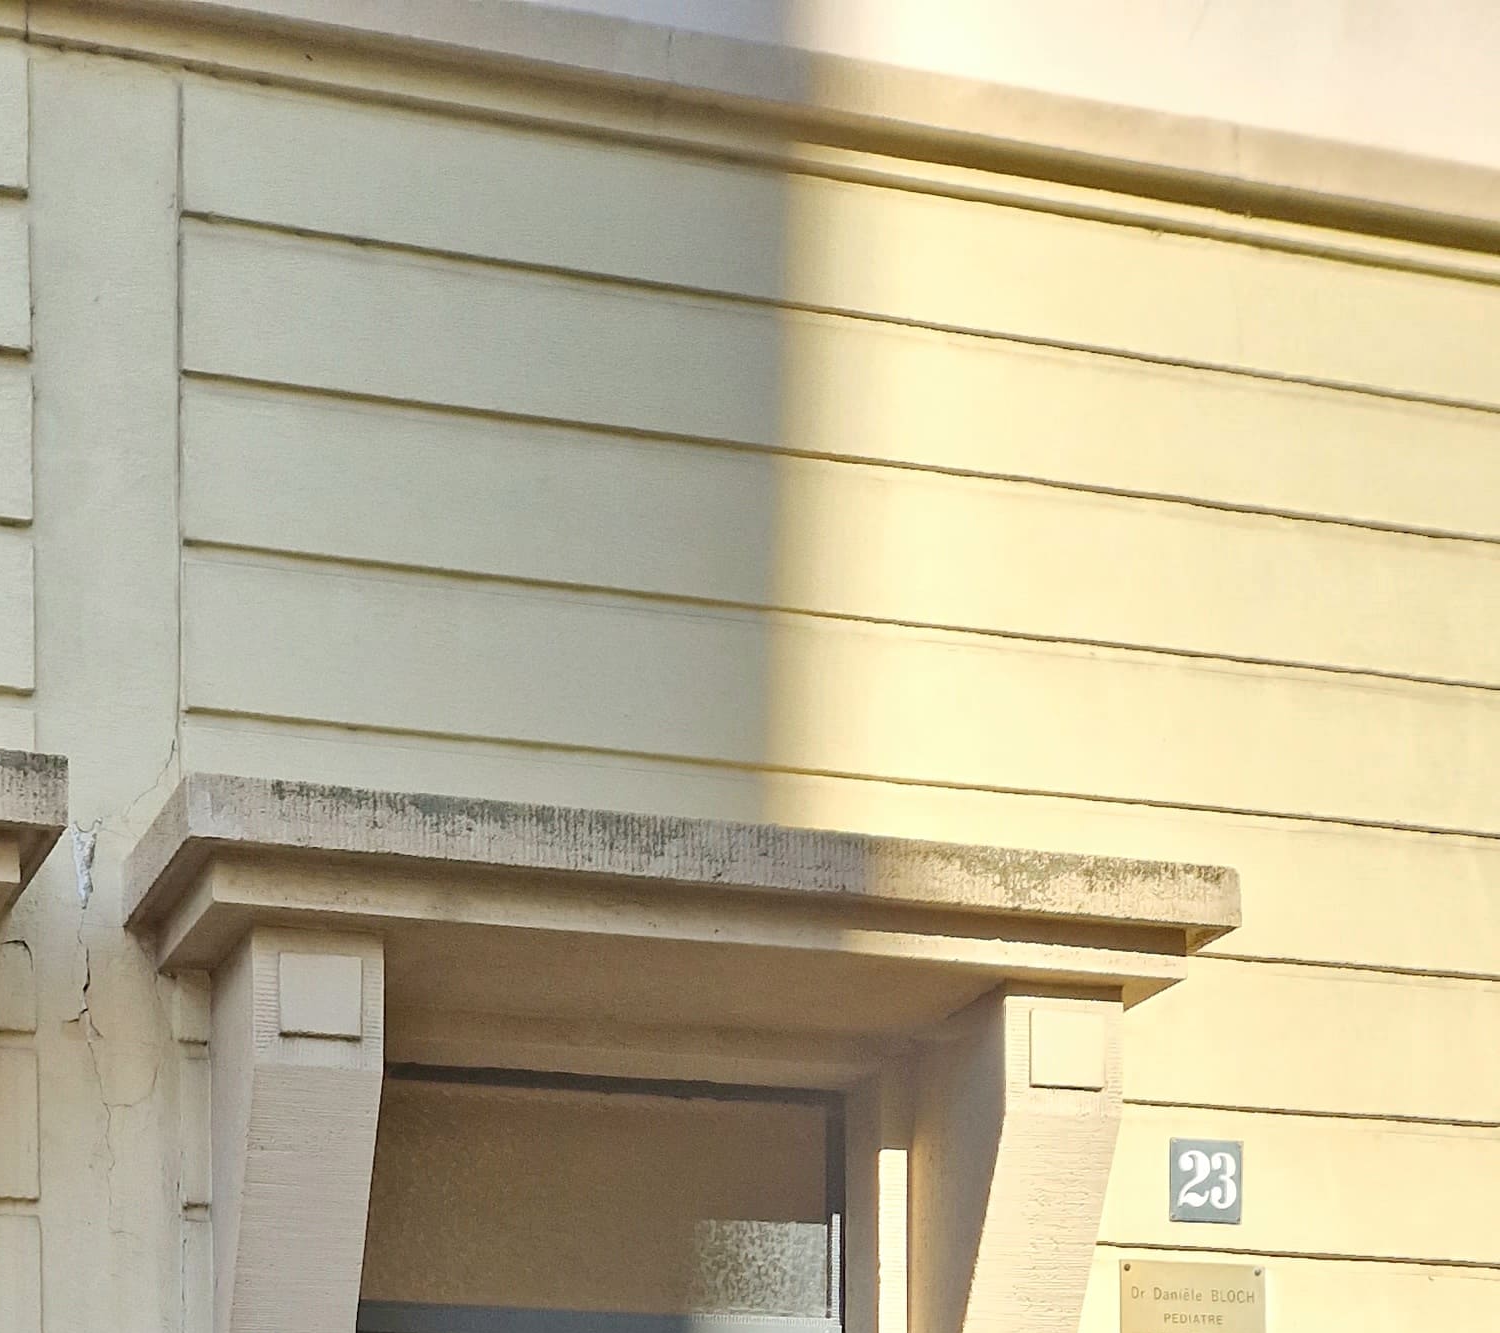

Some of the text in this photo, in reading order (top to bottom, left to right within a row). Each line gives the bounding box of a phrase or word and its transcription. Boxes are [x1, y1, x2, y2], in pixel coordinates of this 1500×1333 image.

[1178, 1150, 1237, 1210] 23
[1131, 1286, 1145, 1299] Dr
[1211, 1289, 1255, 1304] BLOCH
